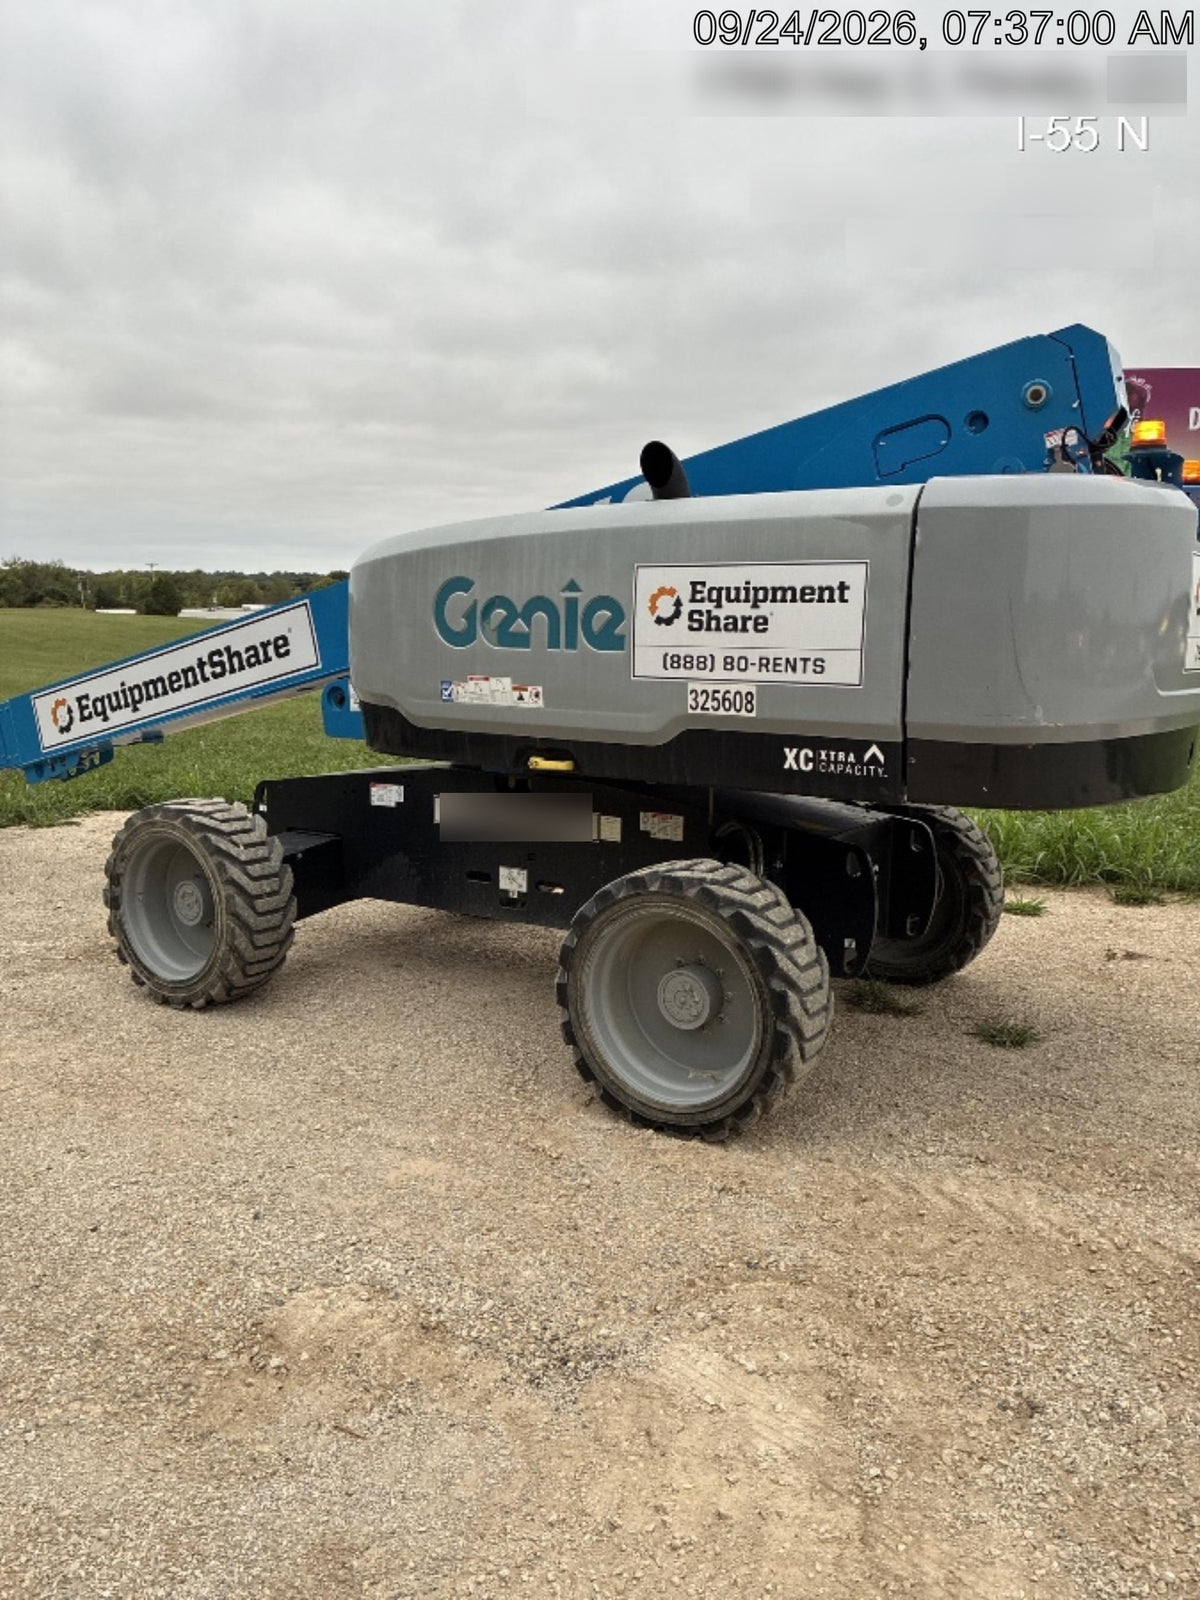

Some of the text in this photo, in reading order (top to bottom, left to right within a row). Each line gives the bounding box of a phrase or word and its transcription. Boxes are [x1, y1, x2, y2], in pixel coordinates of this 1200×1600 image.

[688, 581, 850, 609] Equipment
[433, 575, 627, 653] Genie
[687, 609, 770, 633] Share
[662, 652, 826, 675] (888) 80-RENTS
[75, 631, 292, 724] EquipmentShare
[688, 688, 755, 714] 325608
[783, 747, 814, 772] XC
[819, 749, 856, 764] XTRA
[819, 762, 885, 778] CAPACITY
